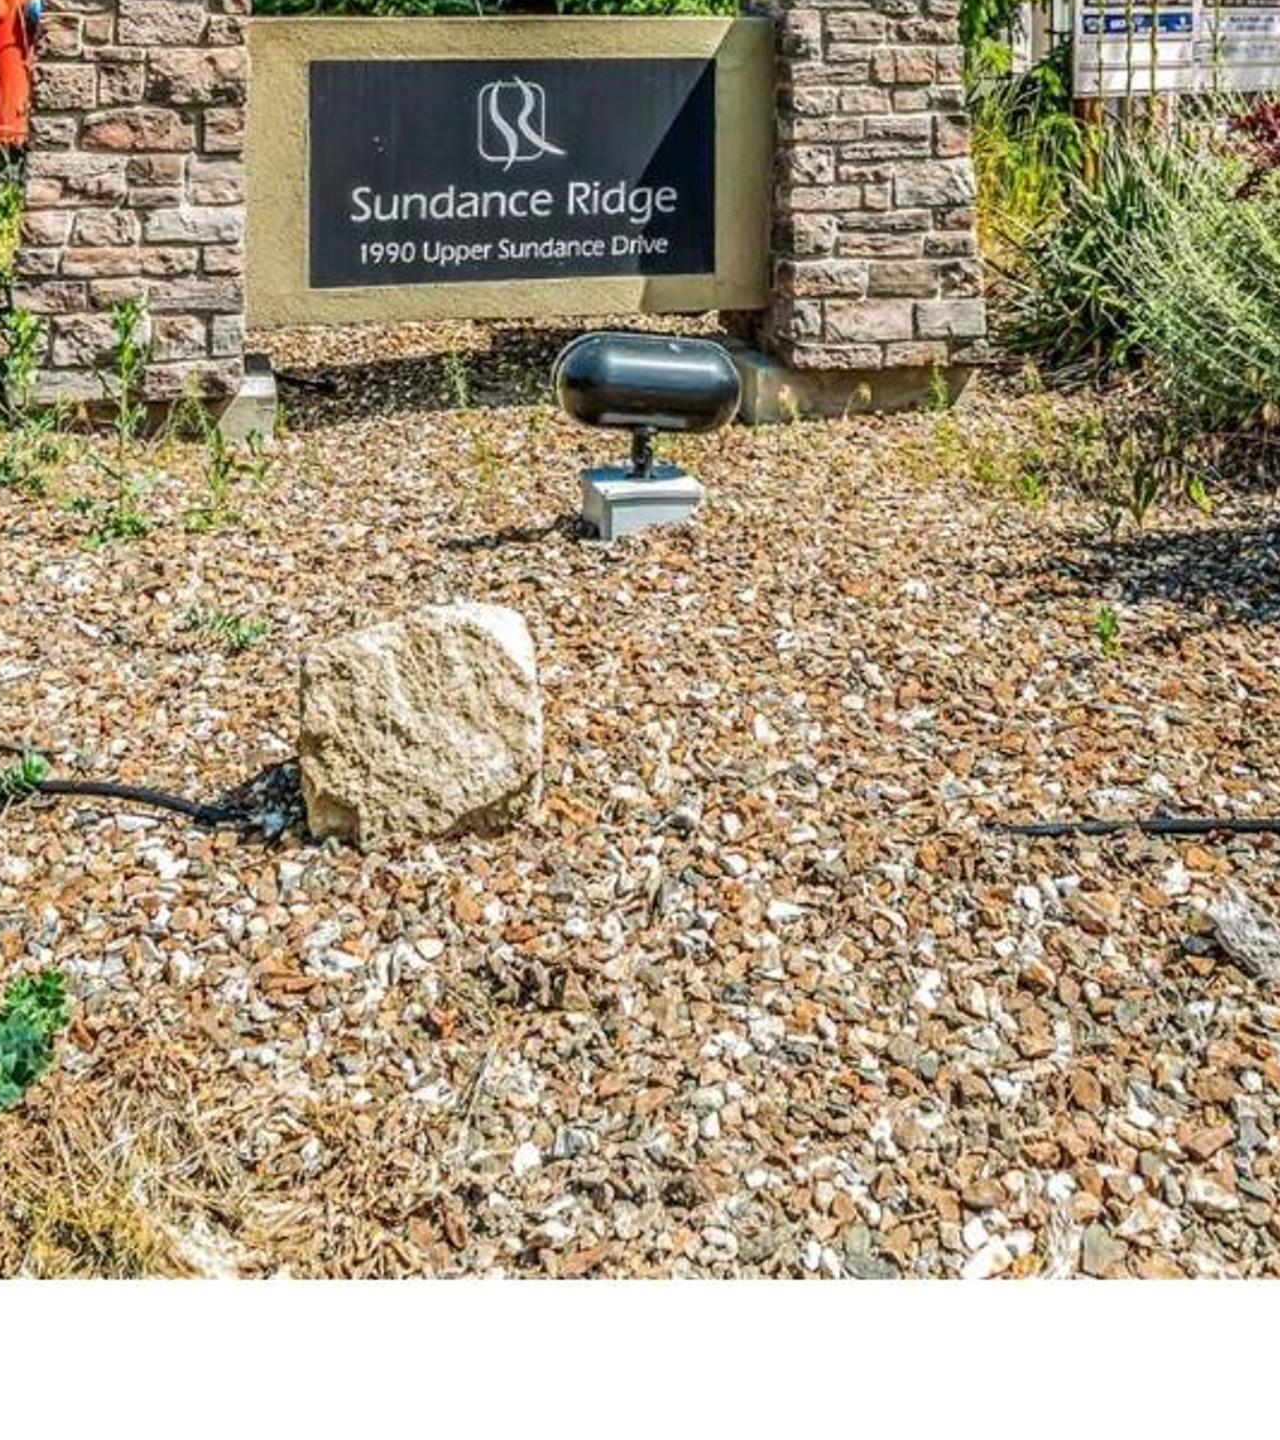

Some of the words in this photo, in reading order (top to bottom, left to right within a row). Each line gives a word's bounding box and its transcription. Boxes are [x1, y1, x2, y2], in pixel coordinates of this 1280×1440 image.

[350, 184, 554, 224] Sundance
[567, 179, 678, 226] Ridge
[360, 241, 416, 266] 1990
[422, 238, 493, 268] Upper
[498, 234, 605, 263] Sundance
[610, 232, 669, 257] Drive
